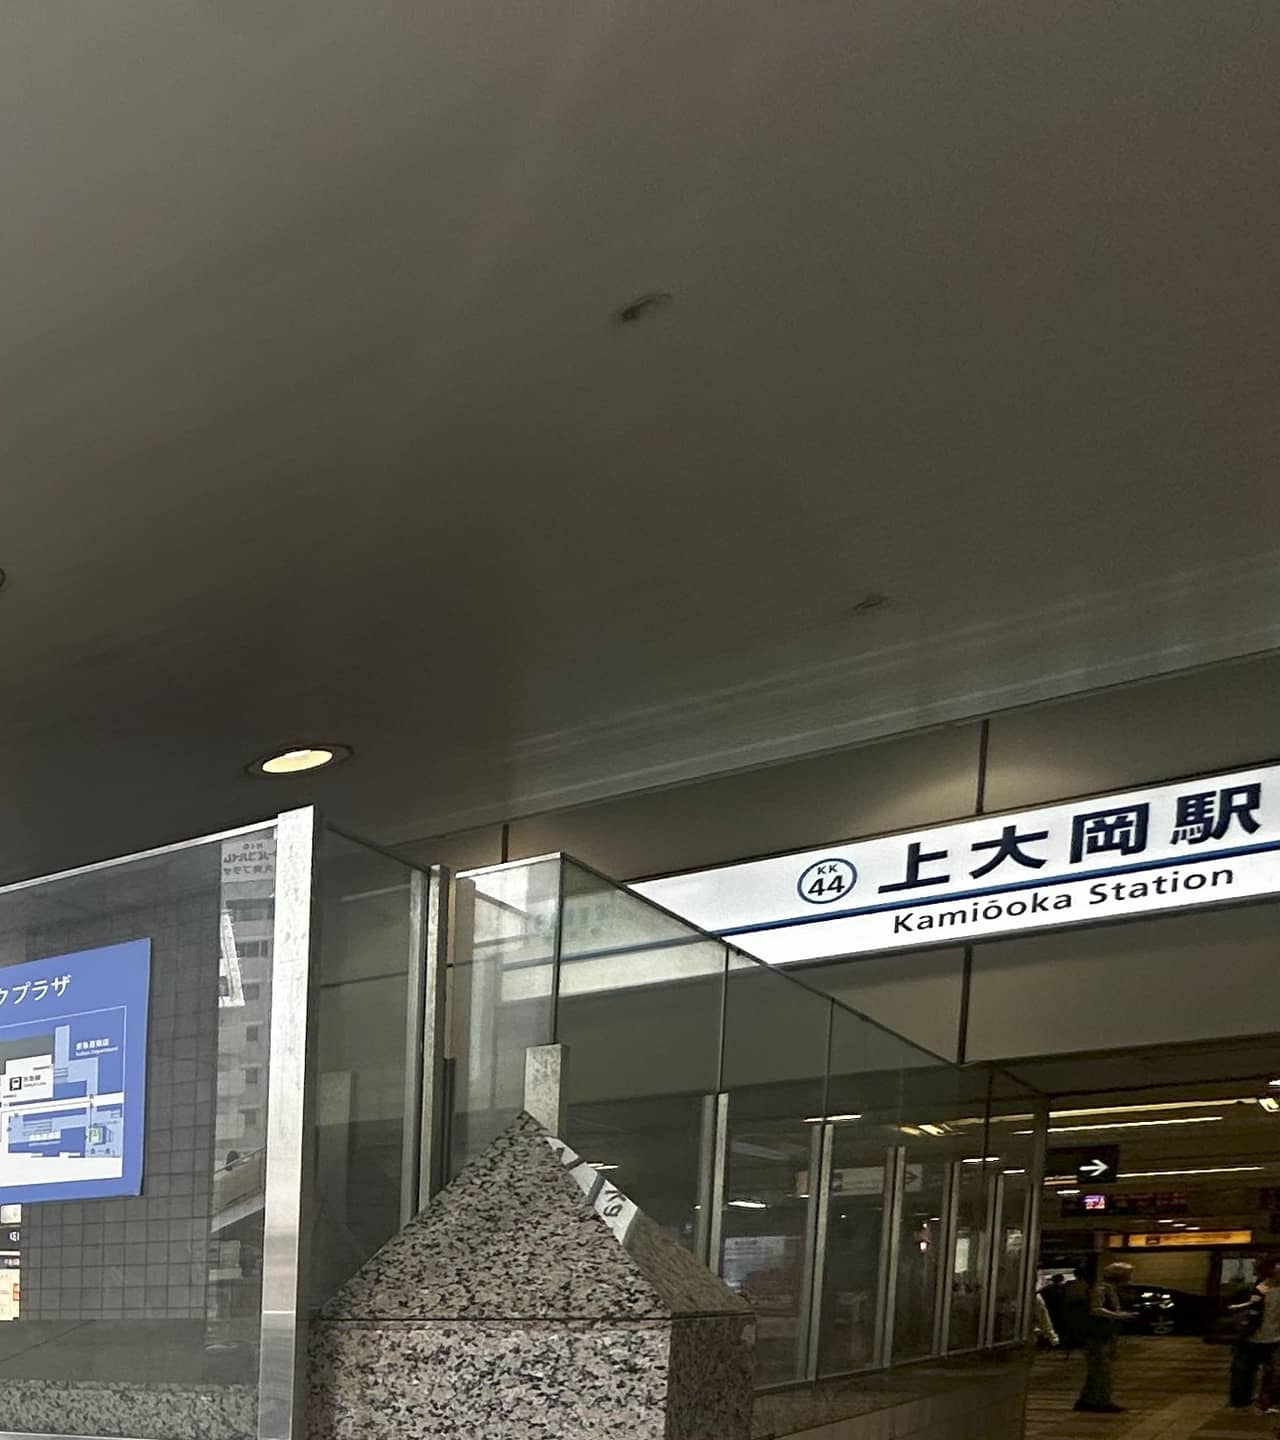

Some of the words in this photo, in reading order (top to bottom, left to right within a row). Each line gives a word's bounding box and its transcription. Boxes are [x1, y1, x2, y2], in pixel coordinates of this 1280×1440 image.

[878, 782, 1262, 894] 上大岡駅
[807, 874, 846, 897] 44
[817, 863, 838, 875] KK
[893, 892, 1072, 935] Kamiōoka
[1088, 867, 1235, 906] Station
